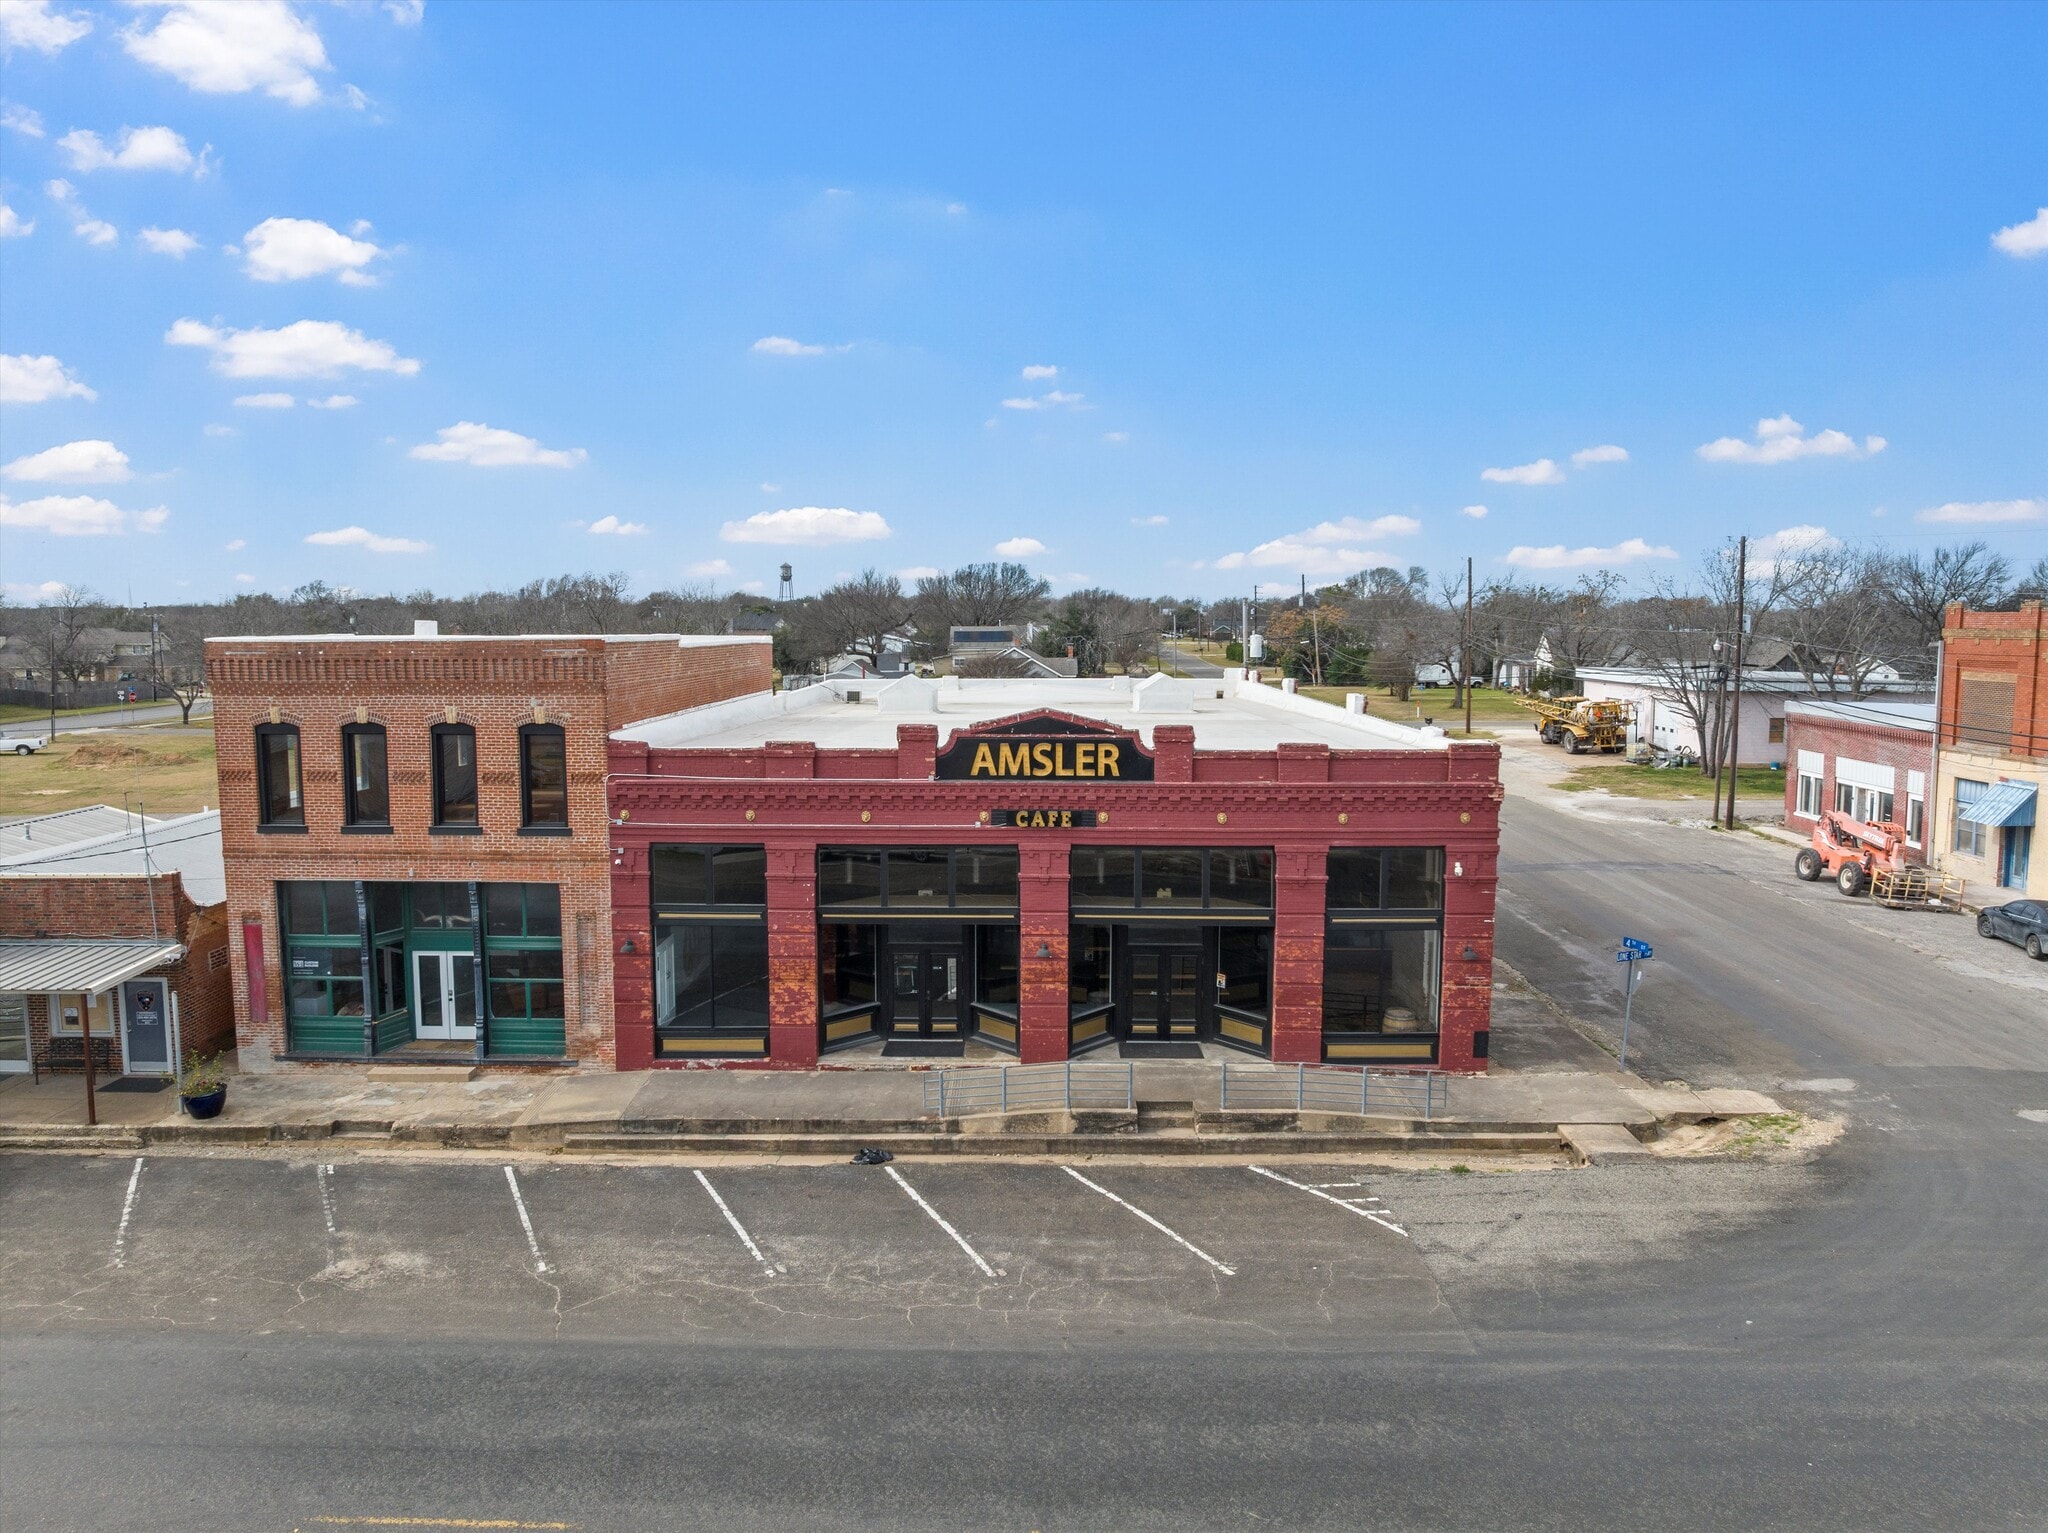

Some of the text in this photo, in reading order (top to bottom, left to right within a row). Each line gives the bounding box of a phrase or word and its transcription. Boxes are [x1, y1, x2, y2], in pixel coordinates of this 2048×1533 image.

[970, 742, 1120, 777] AMSLER
[1015, 811, 1072, 827] CAFE
[1617, 951, 1629, 961] LONE
[1630, 950, 1642, 960] STAR
